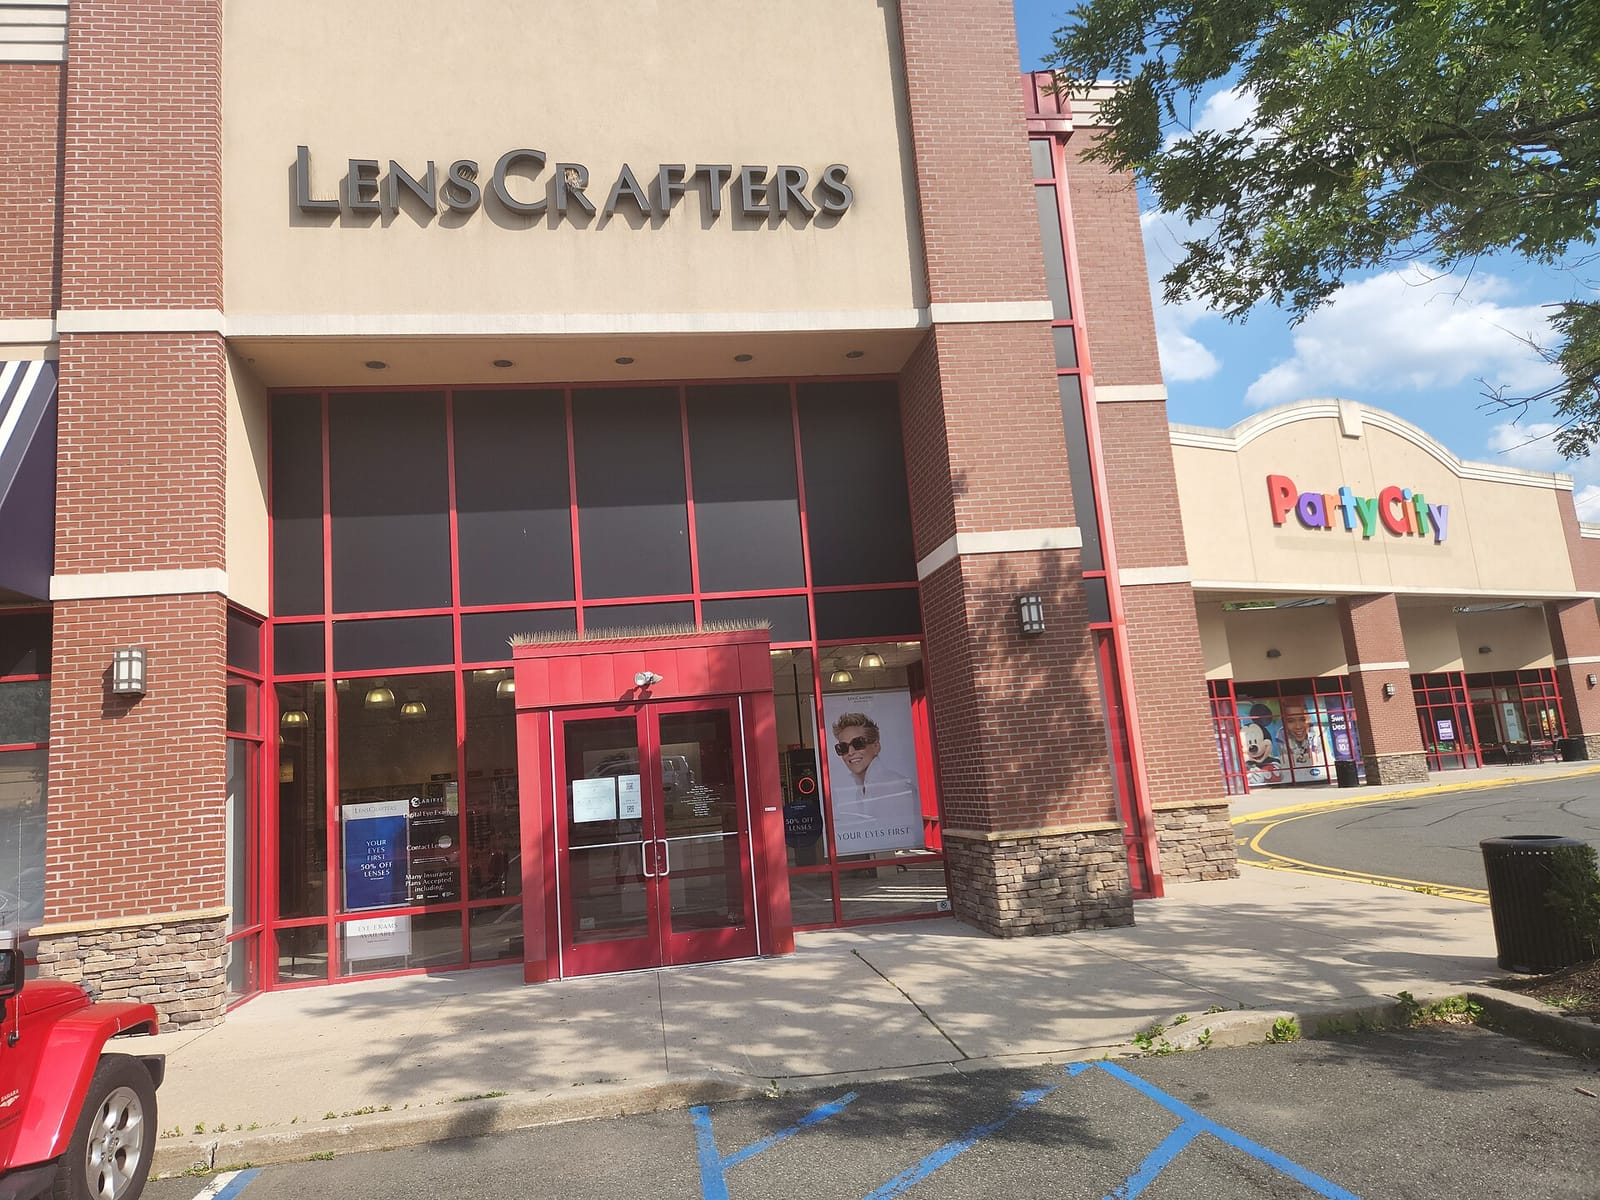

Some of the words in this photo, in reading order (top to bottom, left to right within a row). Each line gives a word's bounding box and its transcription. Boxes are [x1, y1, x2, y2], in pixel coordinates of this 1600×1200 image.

[295, 145, 854, 218] LENSCRAFTERS
[789, 823, 812, 832] LENSES
[838, 832, 862, 841] YOUR
[865, 829, 885, 839] EYES
[888, 826, 910, 836] FIRST
[406, 843, 430, 851] Contact
[364, 869, 390, 877] LENSES
